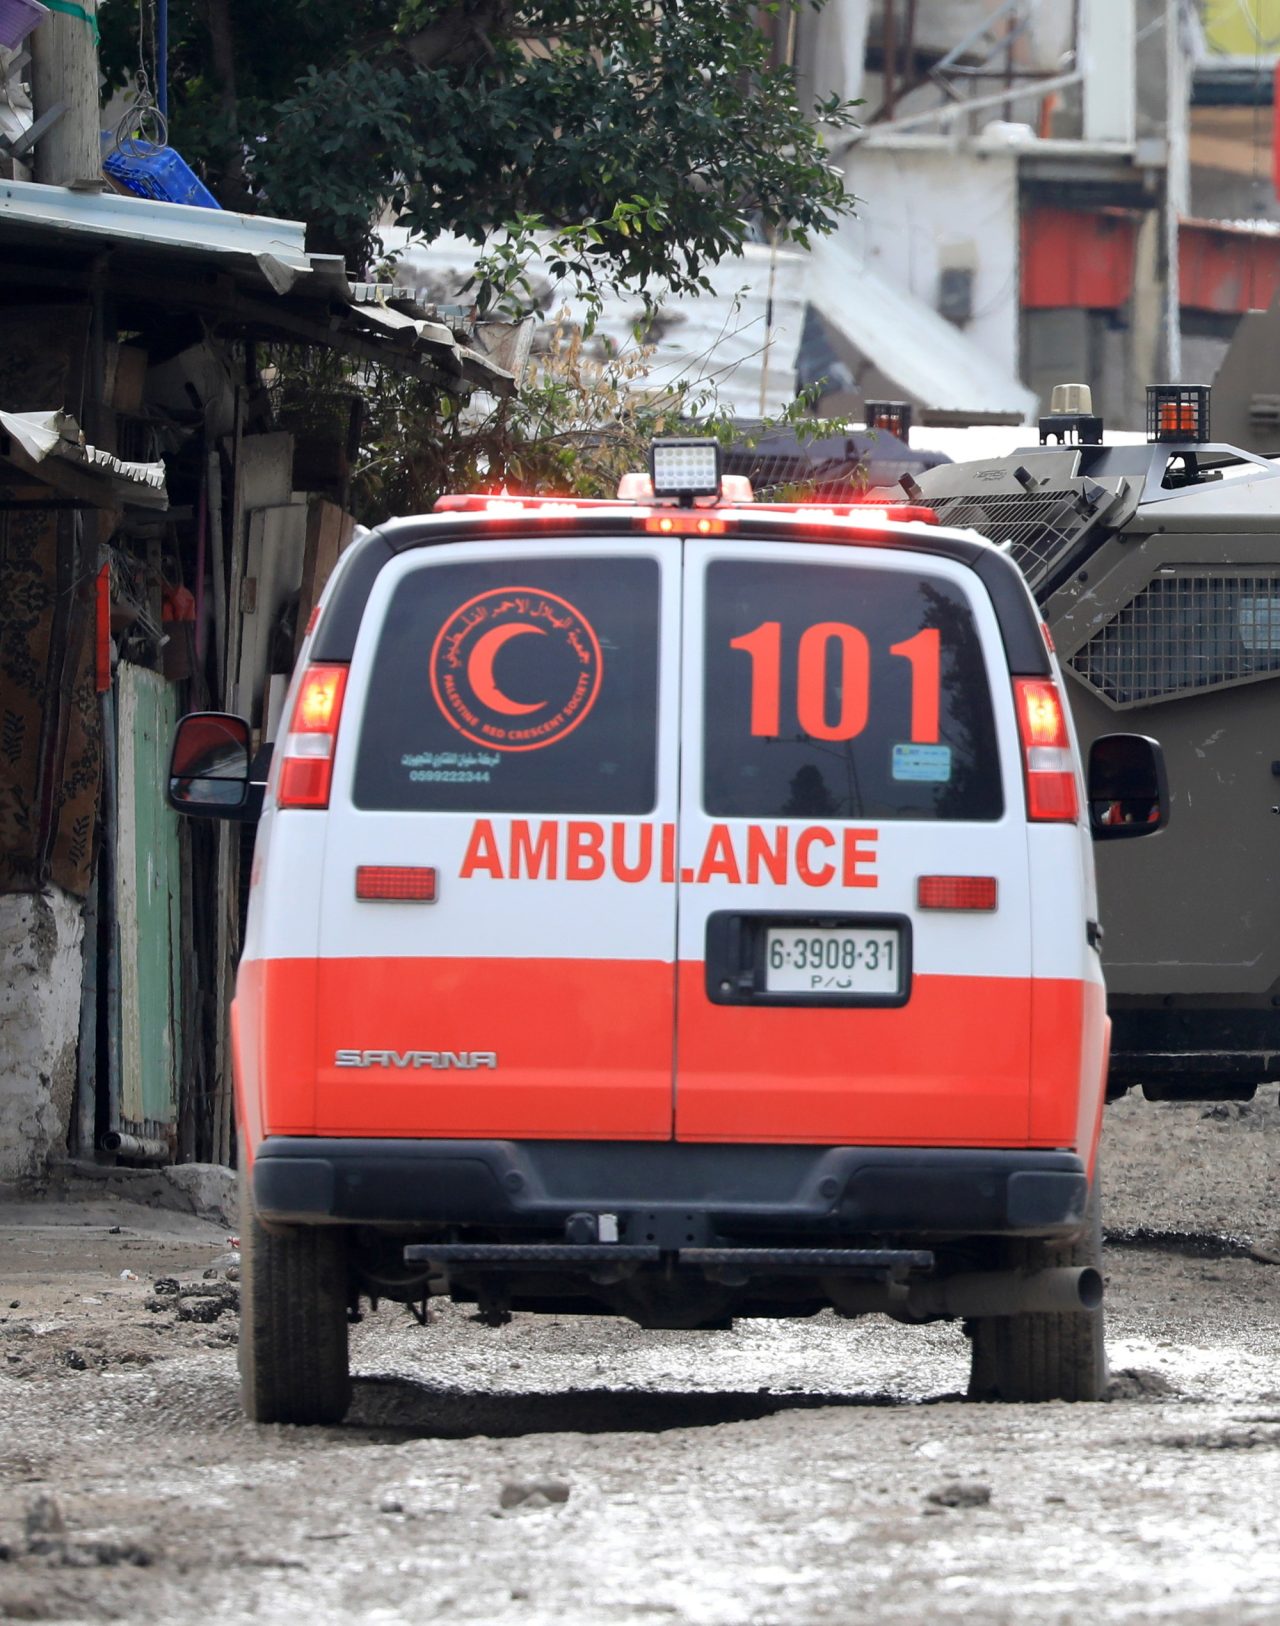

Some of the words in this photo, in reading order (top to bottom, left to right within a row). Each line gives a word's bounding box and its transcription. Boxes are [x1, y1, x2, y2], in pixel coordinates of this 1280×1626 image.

[443, 674, 480, 727] PALESTINE
[481, 723, 506, 739] RED
[507, 713, 566, 740] CRESCENT
[563, 671, 590, 717] SOCIETY
[729, 620, 941, 744] 101
[459, 818, 879, 888] AMBULANCE
[335, 1049, 497, 1070] SAVANA
